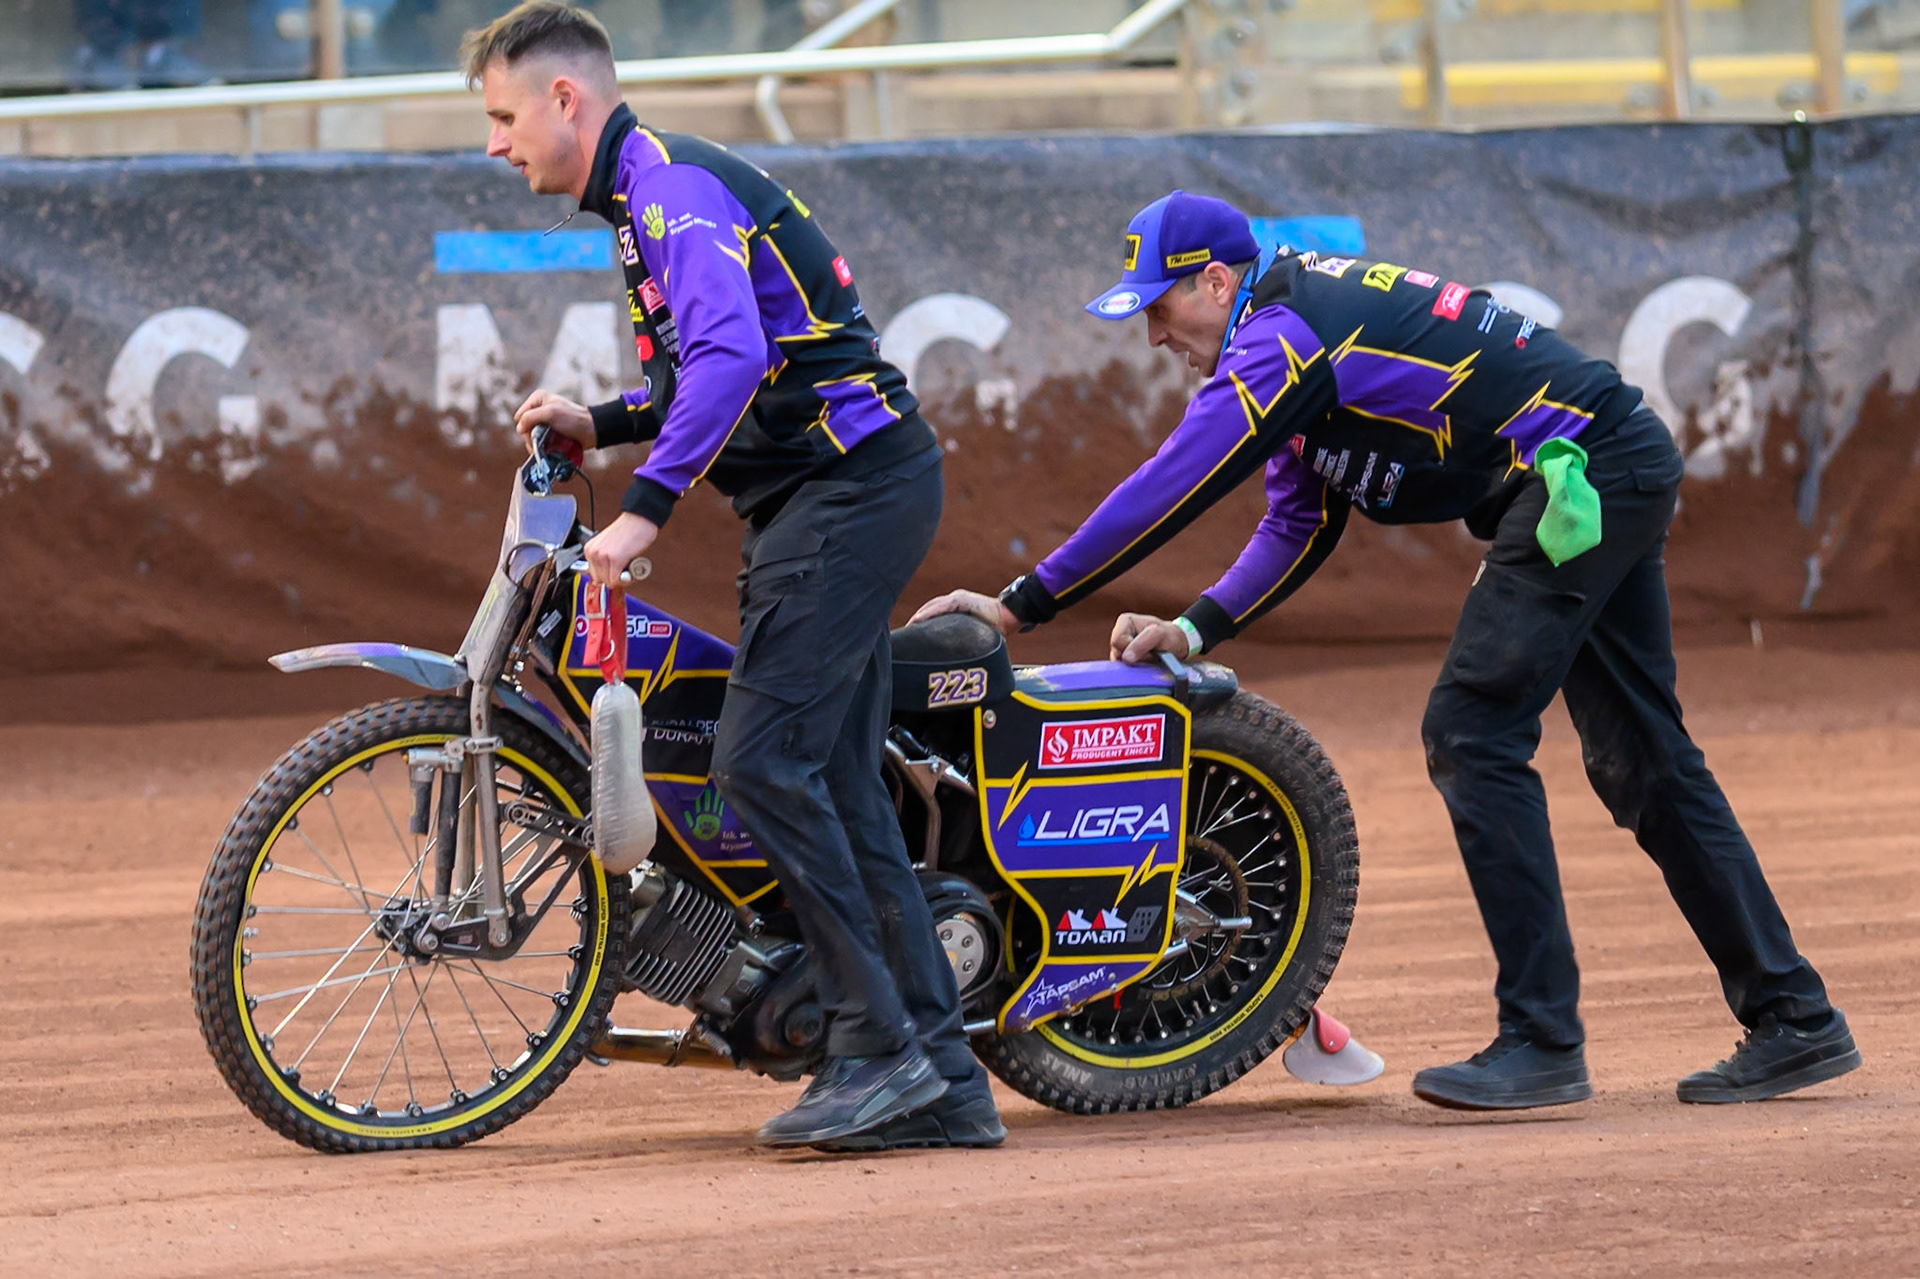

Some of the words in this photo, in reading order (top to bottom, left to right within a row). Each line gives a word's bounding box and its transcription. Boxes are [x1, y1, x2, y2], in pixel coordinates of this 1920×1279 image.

[928, 668, 988, 708] 223
[1072, 723, 1158, 748] IMPAKT
[1071, 748, 1122, 760] PRODUCENT
[1124, 745, 1155, 756] ZNICZY
[1034, 803, 1170, 842] LIGRA
